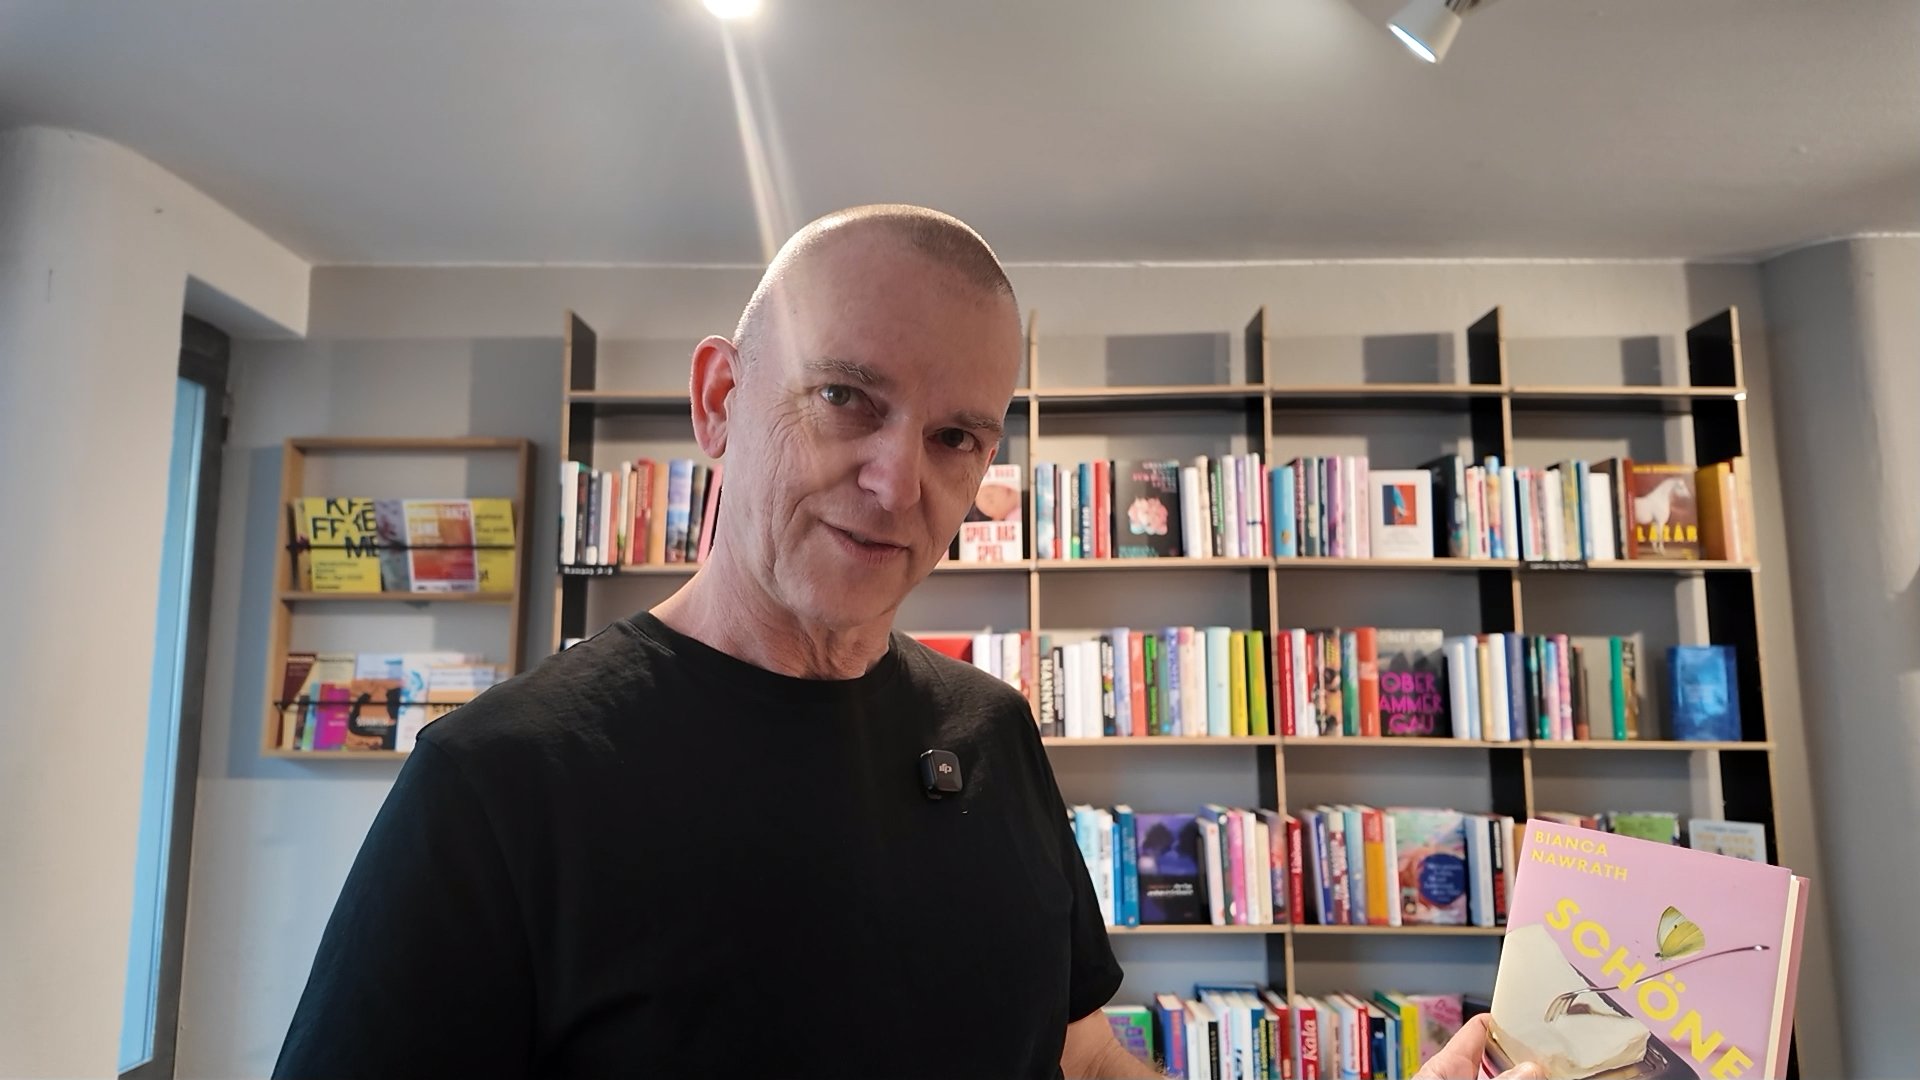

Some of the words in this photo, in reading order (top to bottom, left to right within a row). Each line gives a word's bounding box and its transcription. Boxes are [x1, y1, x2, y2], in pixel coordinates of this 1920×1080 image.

[1381, 670, 1436, 694] OBER
[1379, 693, 1443, 714] AMMER
[1389, 713, 1435, 735] GAU
[1534, 830, 1609, 857] BIANCA
[1530, 848, 1628, 881] NAWRATH
[1544, 897, 1754, 1080] SCHÖNE
[1302, 1019, 1319, 1061] Kala
